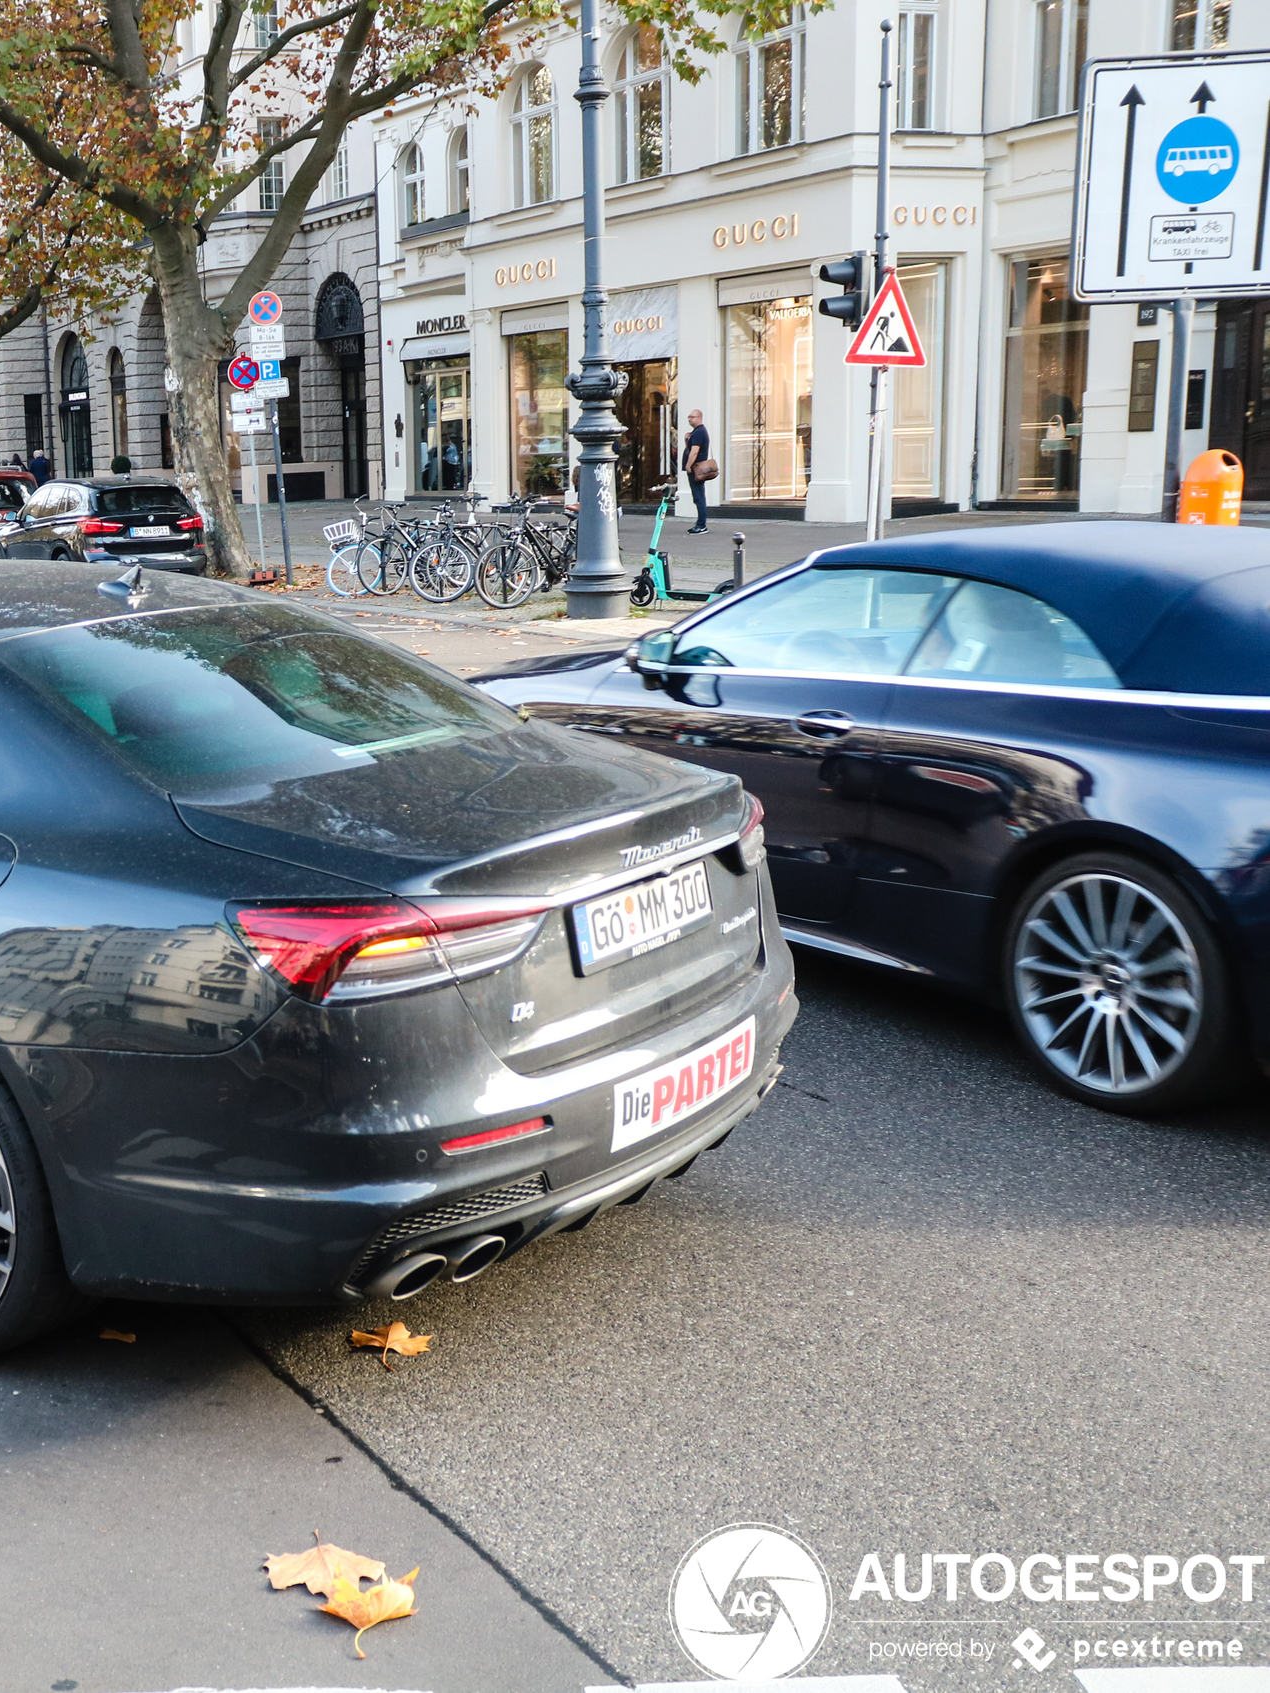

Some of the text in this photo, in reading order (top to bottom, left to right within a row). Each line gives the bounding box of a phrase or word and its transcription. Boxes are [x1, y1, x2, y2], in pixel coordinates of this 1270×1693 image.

[892, 205, 977, 226] GUCCI
[713, 212, 799, 249] GUCCI
[1152, 235, 1229, 246] Krankenfahrzeuge
[1172, 247, 1209, 256] TAXI frei
[495, 258, 557, 287] GUCCI
[749, 289, 780, 300] GUCCI
[416, 314, 467, 335] MONCLER
[1140, 309, 1154, 319] 192
[614, 315, 663, 335] GUCCI
[262, 362, 273, 379] P
[619, 826, 704, 868] Maserati
[591, 900, 624, 951] GÖ
[637, 884, 670, 934] MM
[669, 869, 707, 920] 300
[632, 935, 666, 957] AUTO NAGEL
[622, 1028, 751, 1126] Die PARTEI
